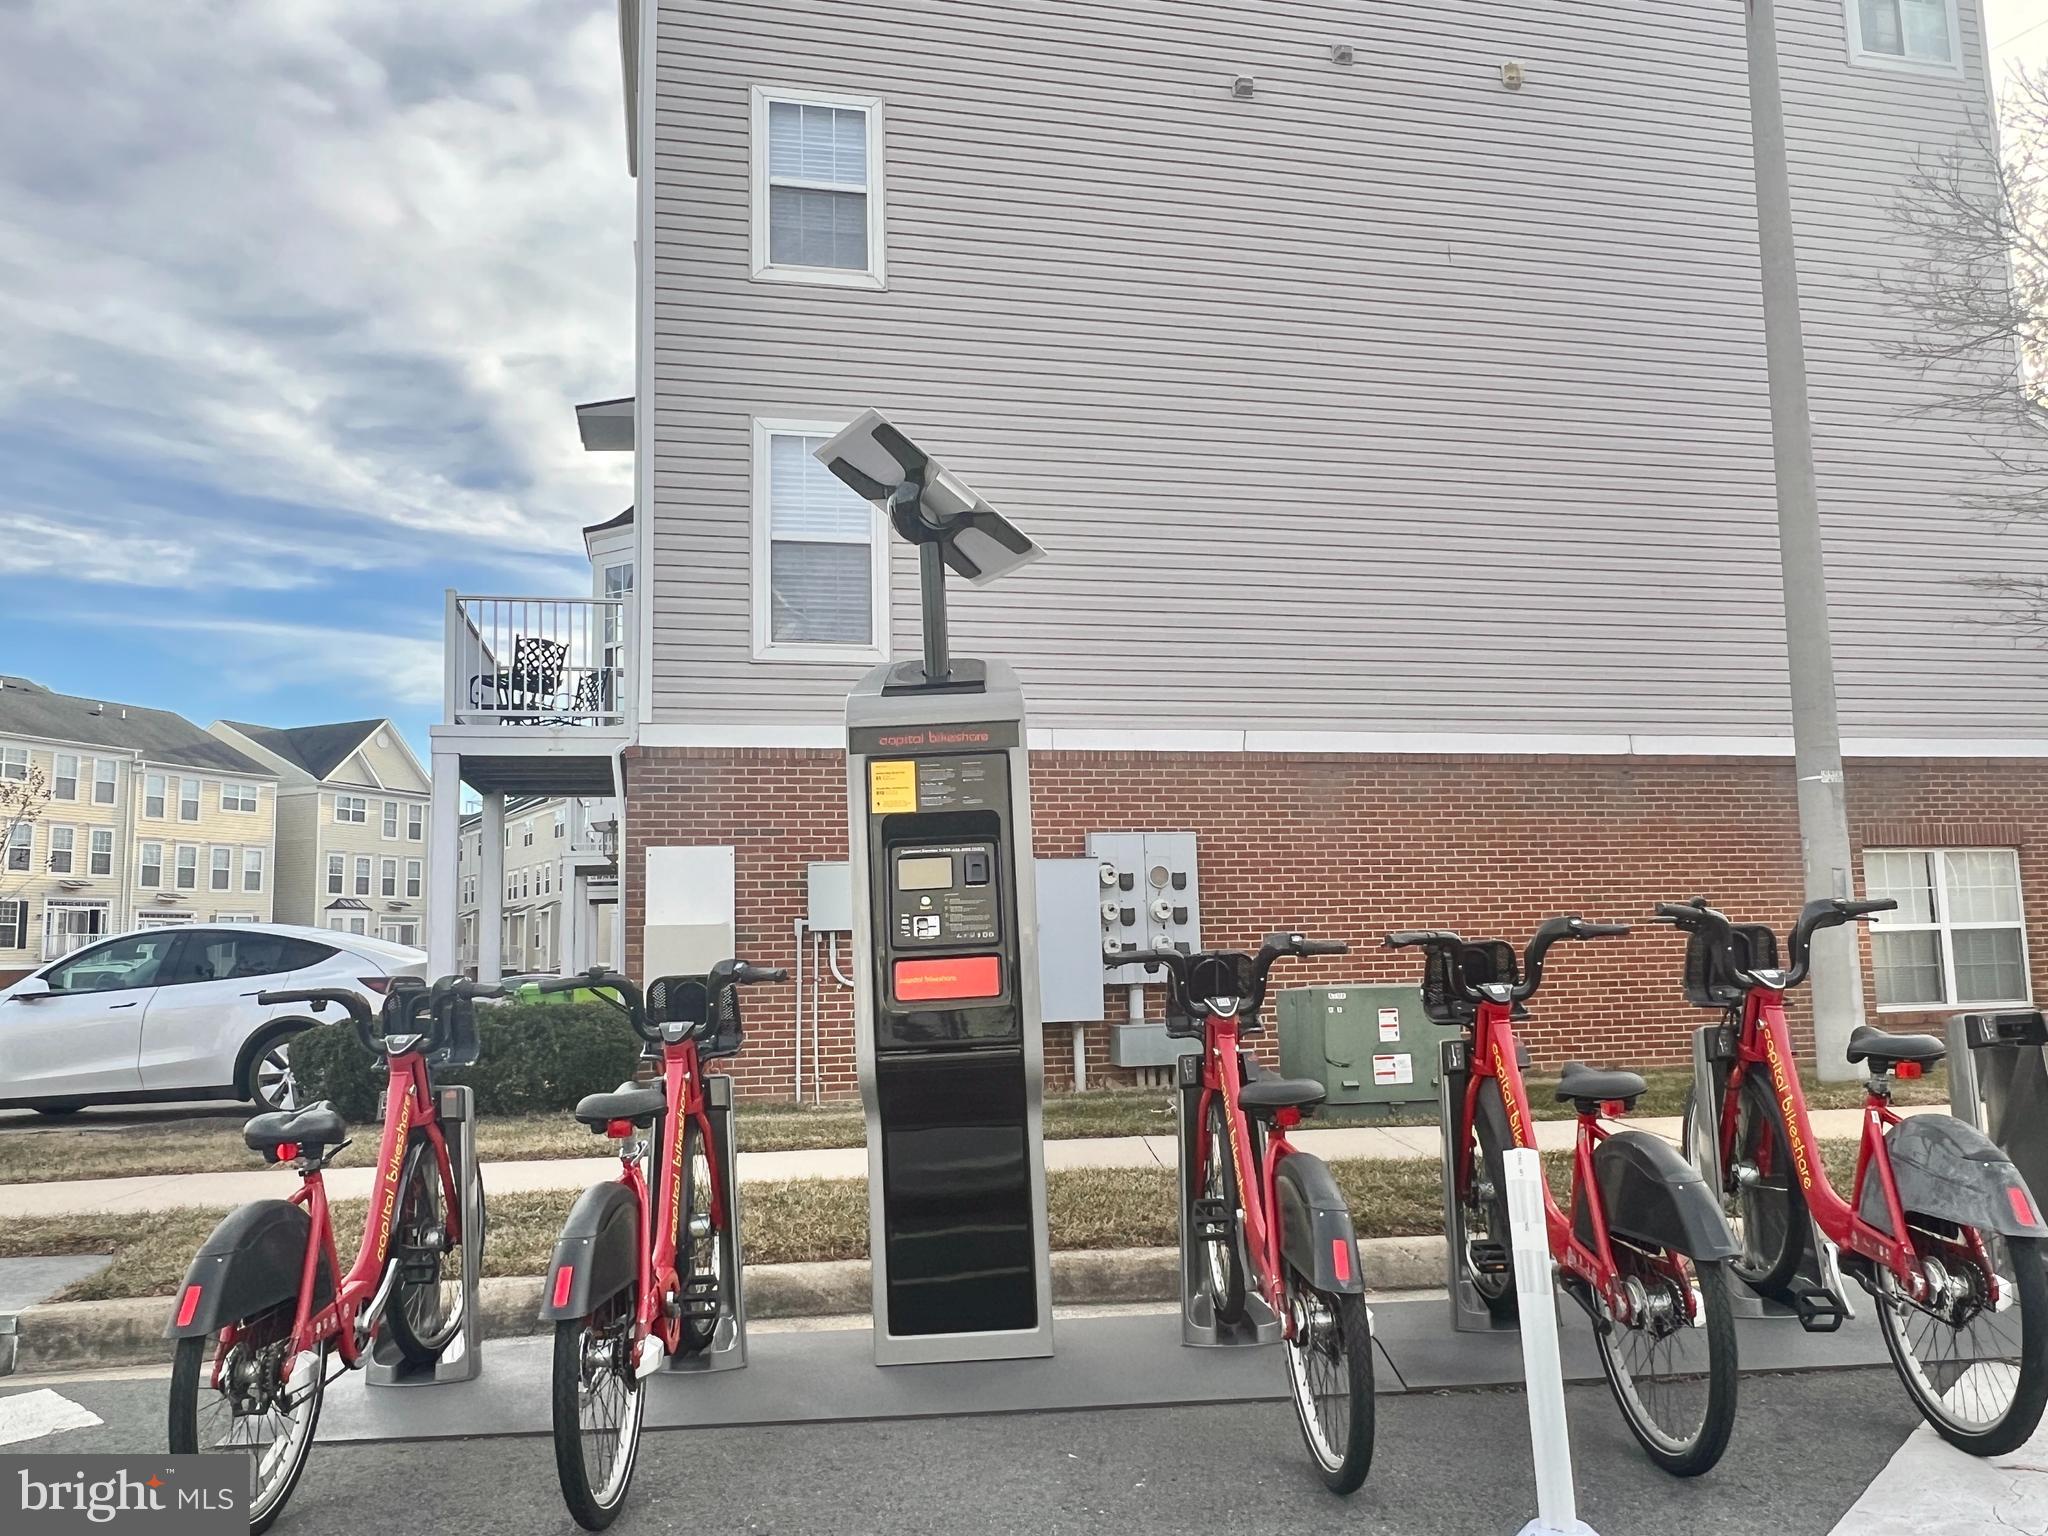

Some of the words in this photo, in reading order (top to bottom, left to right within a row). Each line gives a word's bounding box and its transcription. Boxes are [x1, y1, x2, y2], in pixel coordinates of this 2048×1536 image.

[879, 733, 924, 747] capital
[928, 730, 989, 743] bikeshare
[1492, 1043, 1516, 1108] capital
[1764, 1028, 1789, 1092] capital
[1781, 1094, 1812, 1190] bikeshare
[385, 1094, 411, 1182] bikeshare
[377, 1188, 394, 1263] capital
[671, 1173, 681, 1246] capital
